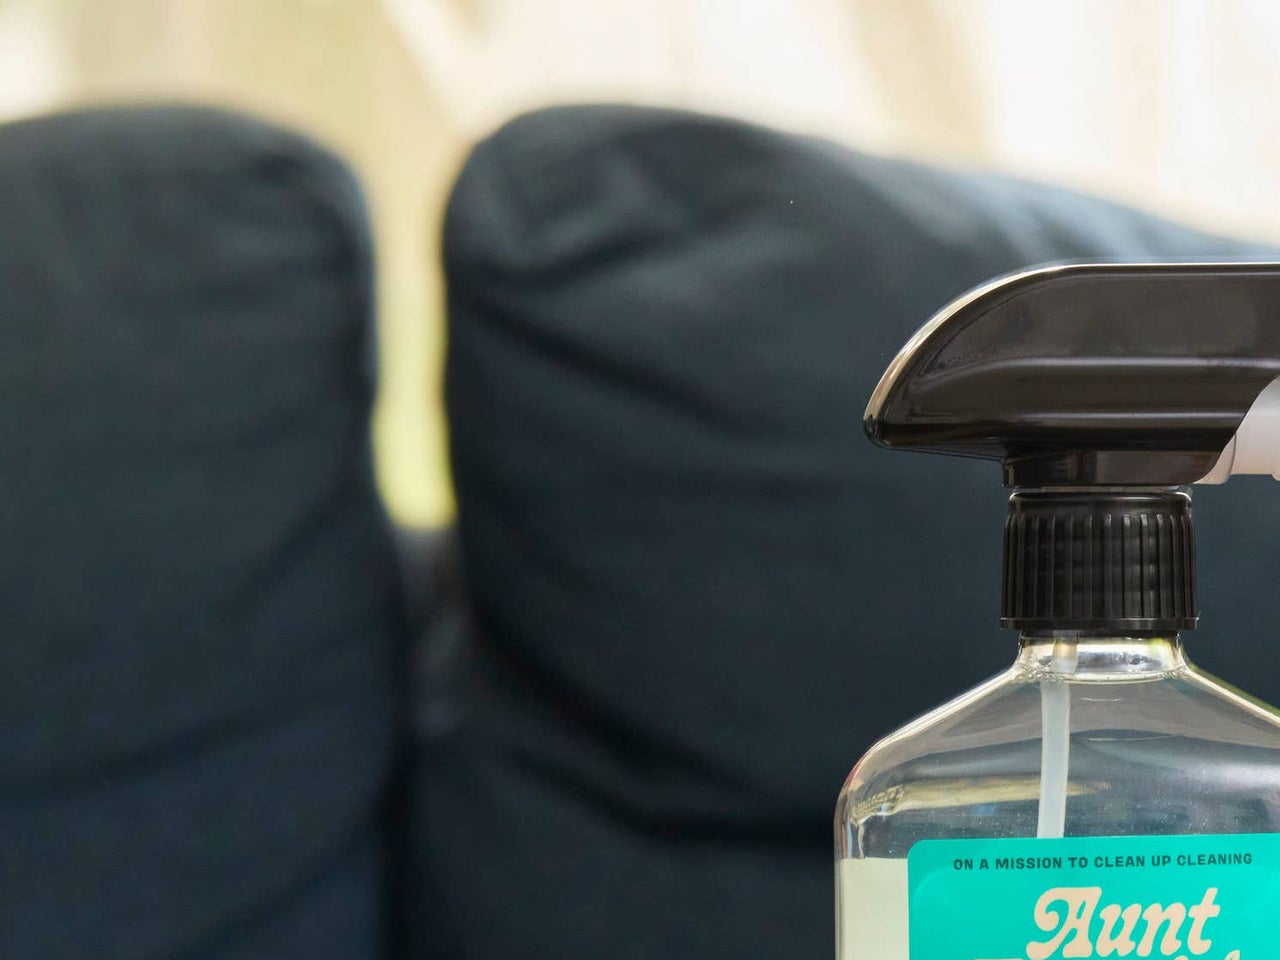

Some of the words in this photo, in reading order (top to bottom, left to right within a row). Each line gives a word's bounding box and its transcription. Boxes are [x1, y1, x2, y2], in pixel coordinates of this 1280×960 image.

[953, 859, 974, 870] ON
[979, 858, 990, 869] A
[995, 857, 1062, 869] MISSION
[1068, 856, 1089, 868] TO
[1094, 855, 1146, 868] CLEAN
[1151, 854, 1171, 867] UP
[1176, 853, 1253, 866] CLEANING
[1026, 887, 1220, 960] Aunt
